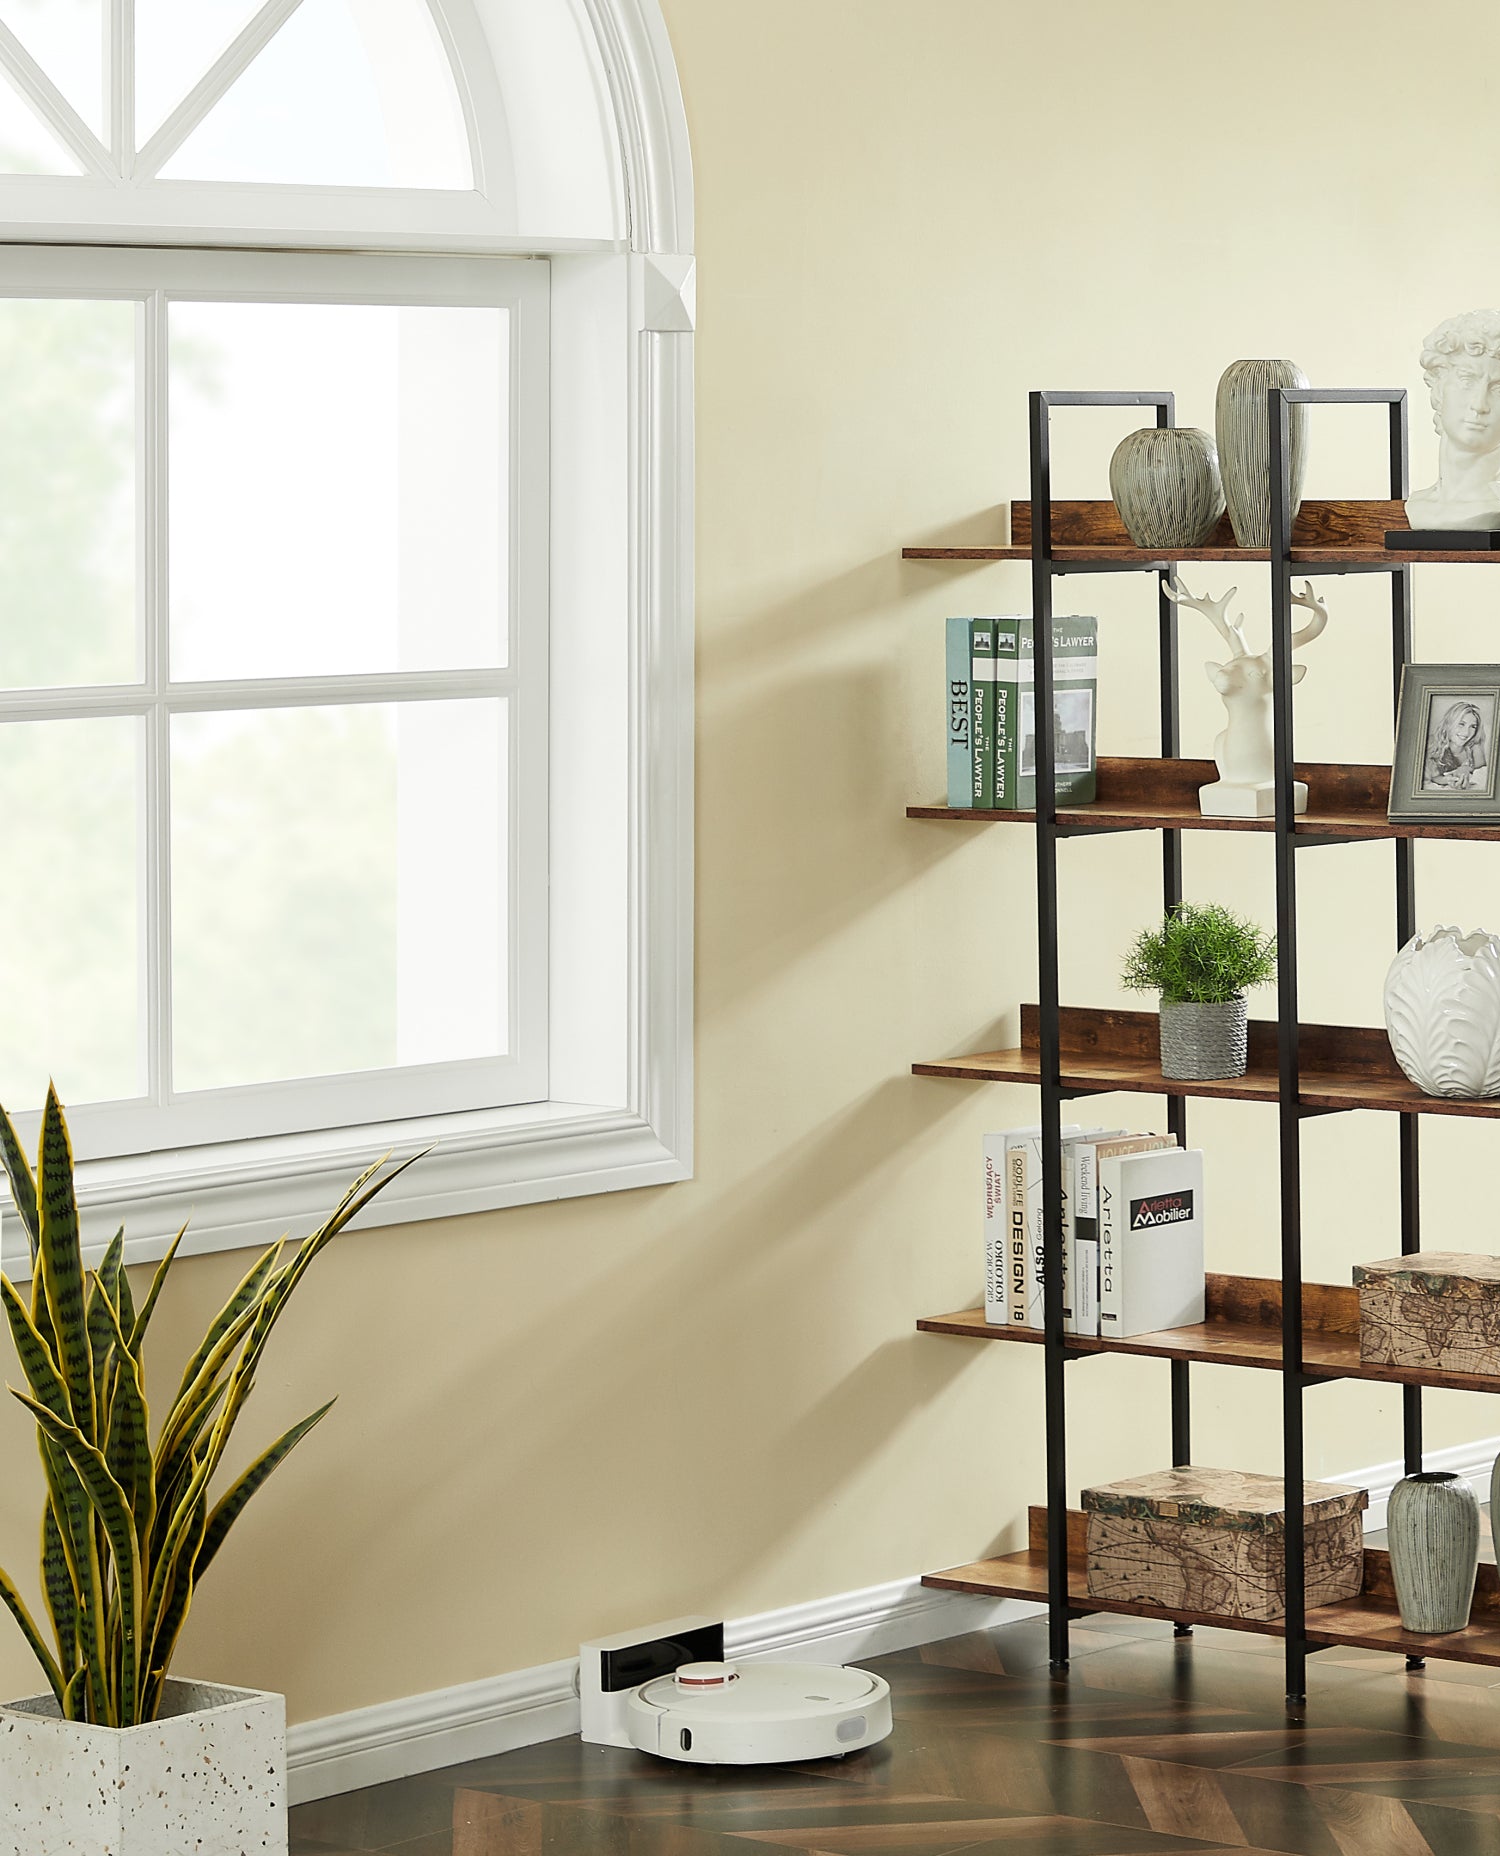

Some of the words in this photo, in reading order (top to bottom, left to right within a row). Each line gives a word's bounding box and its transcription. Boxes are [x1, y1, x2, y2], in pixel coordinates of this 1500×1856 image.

[1060, 636, 1094, 647] LAWYER
[951, 680, 968, 749] BEST
[974, 688, 983, 745] PEOPLE'S
[997, 689, 1007, 746] PEOPLE'S
[974, 748, 983, 798] LAWYER
[996, 749, 1006, 799] LAWYER
[1081, 1156, 1091, 1191] Weekend
[1132, 1207, 1191, 1227] Mobilier
[1139, 1197, 1182, 1214] Arletta
[1012, 1212, 1024, 1294] DESIGN
[1103, 1185, 1113, 1292] Arletta
[1036, 1245, 1045, 1285] ALSO
[1013, 1304, 1024, 1321] 18
